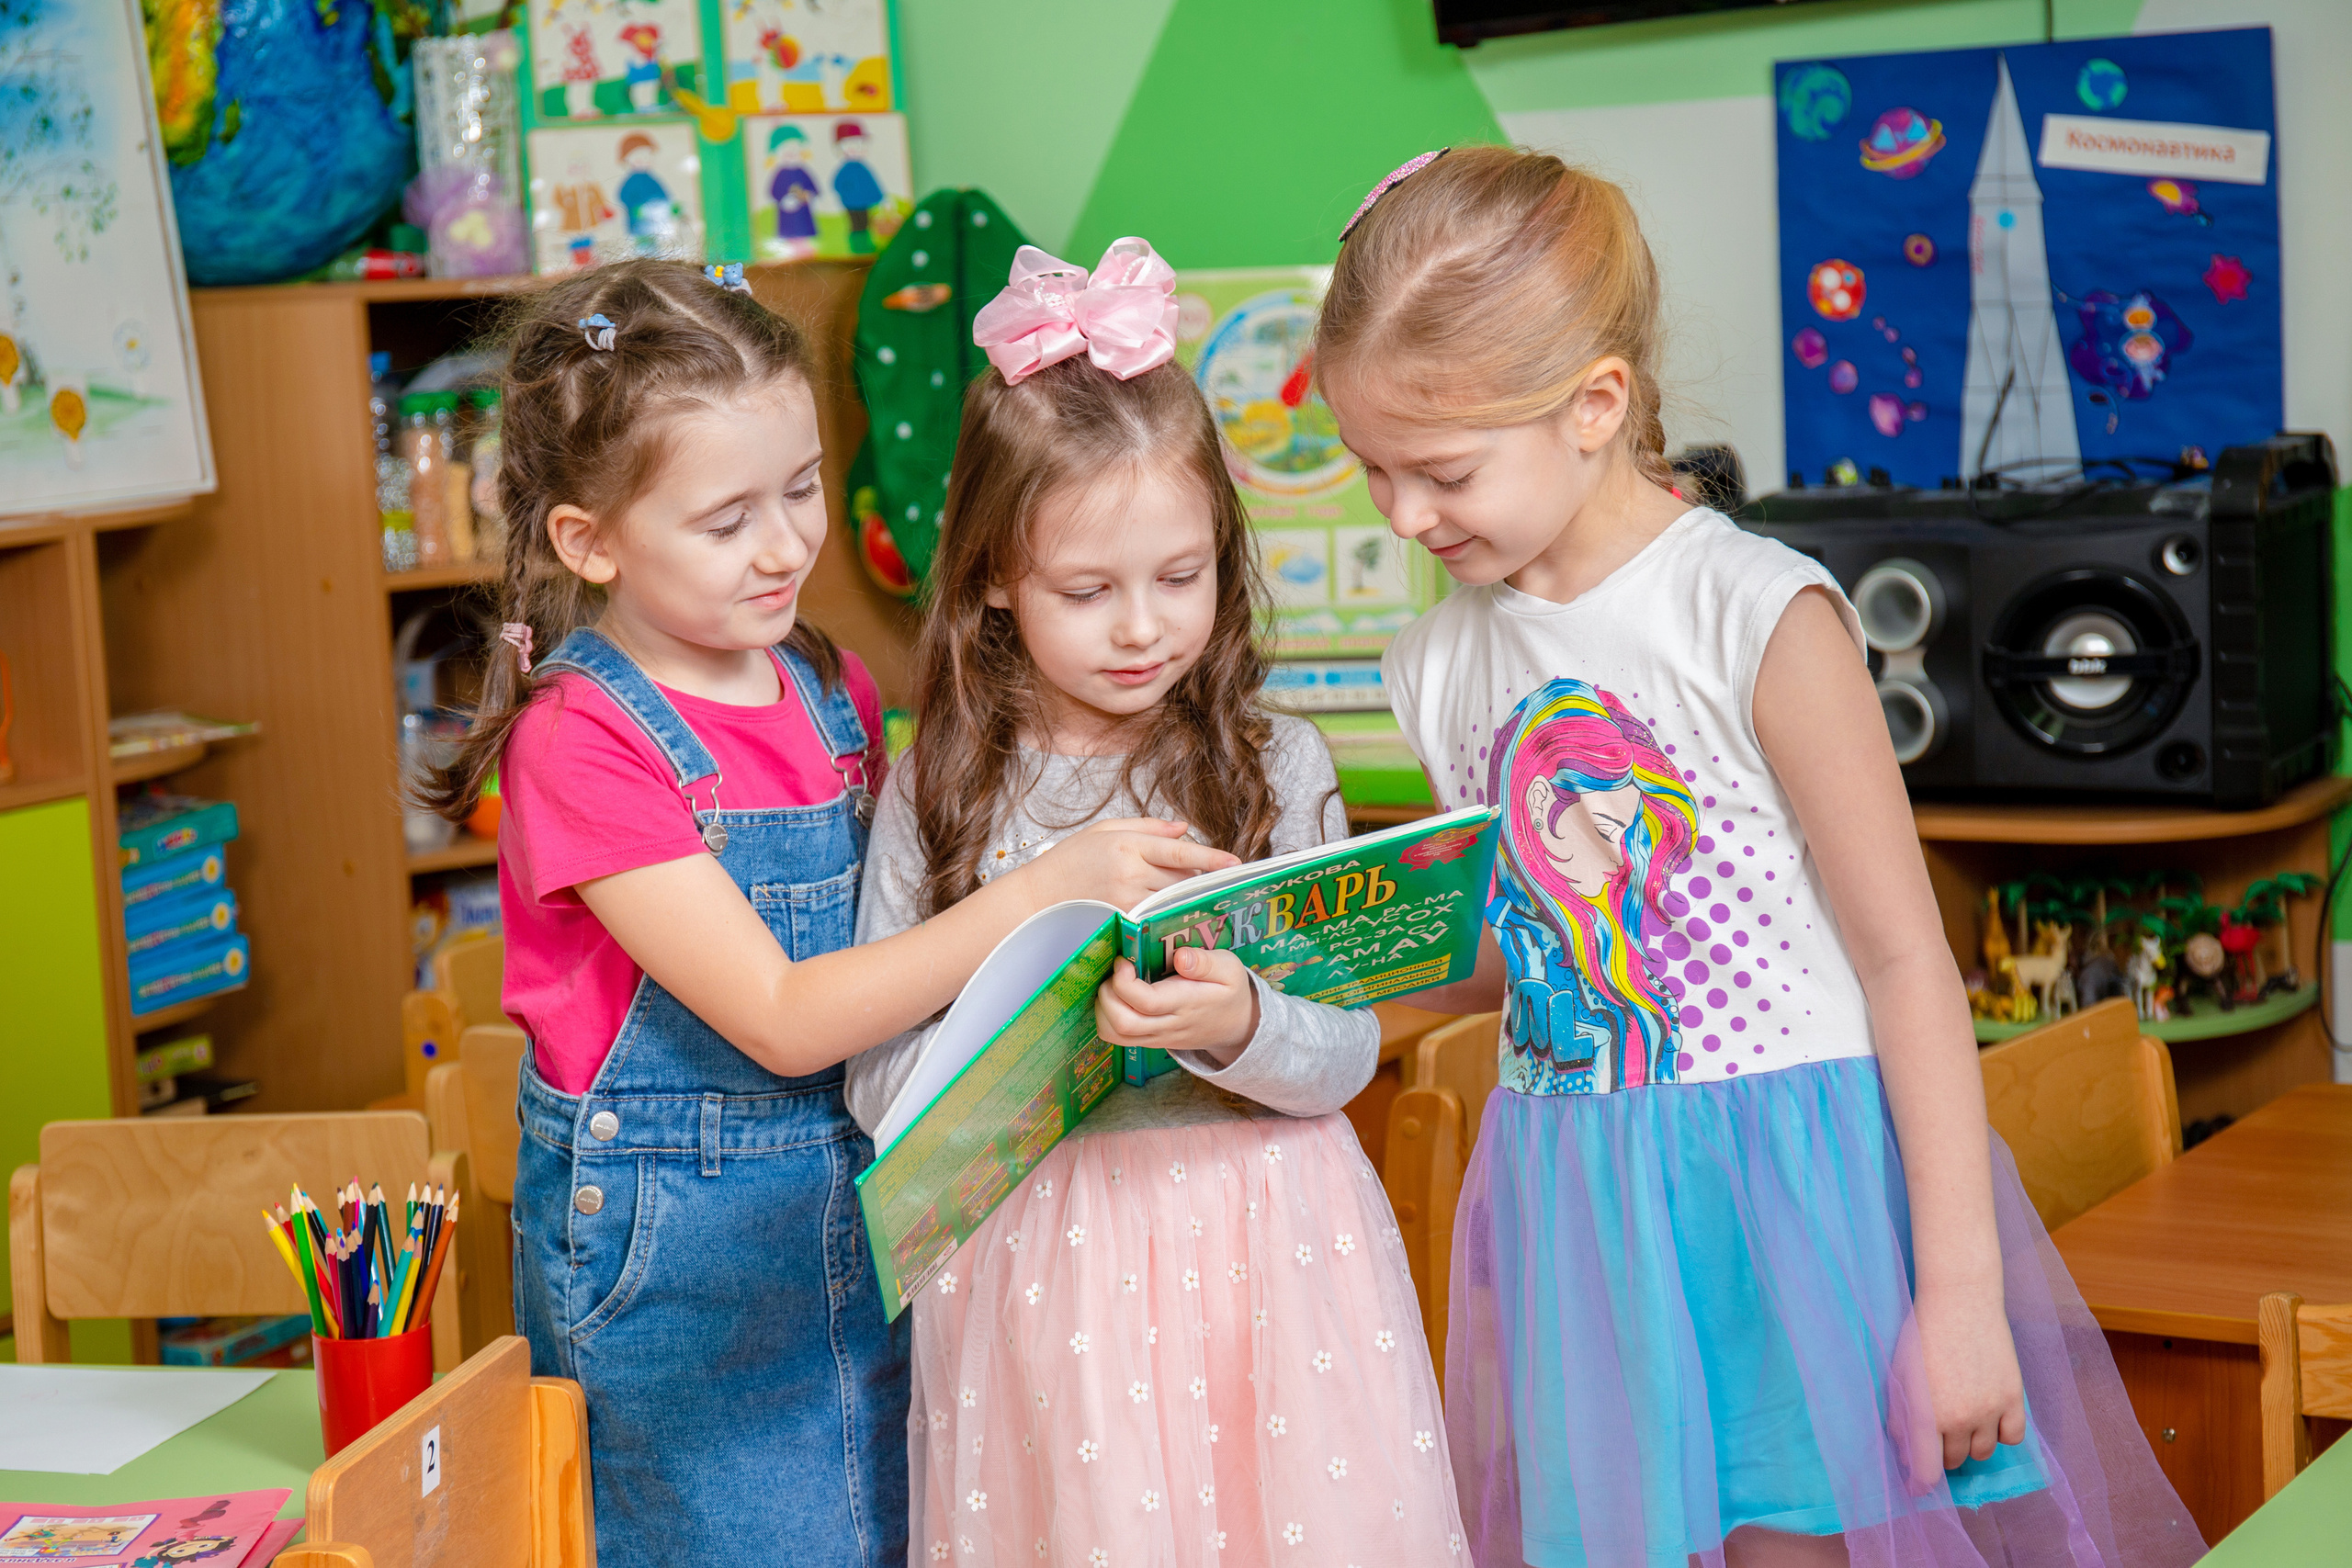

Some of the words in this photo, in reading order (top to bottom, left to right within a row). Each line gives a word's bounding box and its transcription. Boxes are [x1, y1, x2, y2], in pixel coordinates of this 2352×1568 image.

[2065, 126, 2237, 164] Космонавтика
[1241, 859, 1362, 901] ЖУКОВА
[1261, 914, 1372, 953] МА-МА
[1383, 889, 1464, 917] РА-МА
[1289, 927, 1356, 952] МЫ-ЛО
[1329, 924, 1406, 952] РО-ЗА
[1327, 953, 1404, 980] ЛУ-НА
[1346, 958, 1443, 987] ТРАДИЦИОННОЙ
[1347, 967, 1442, 996] ОРИГИНАЛЬНОЙ
[1376, 976, 1441, 997] МЕТОДИКИ
[427, 1439, 435, 1474] 2
